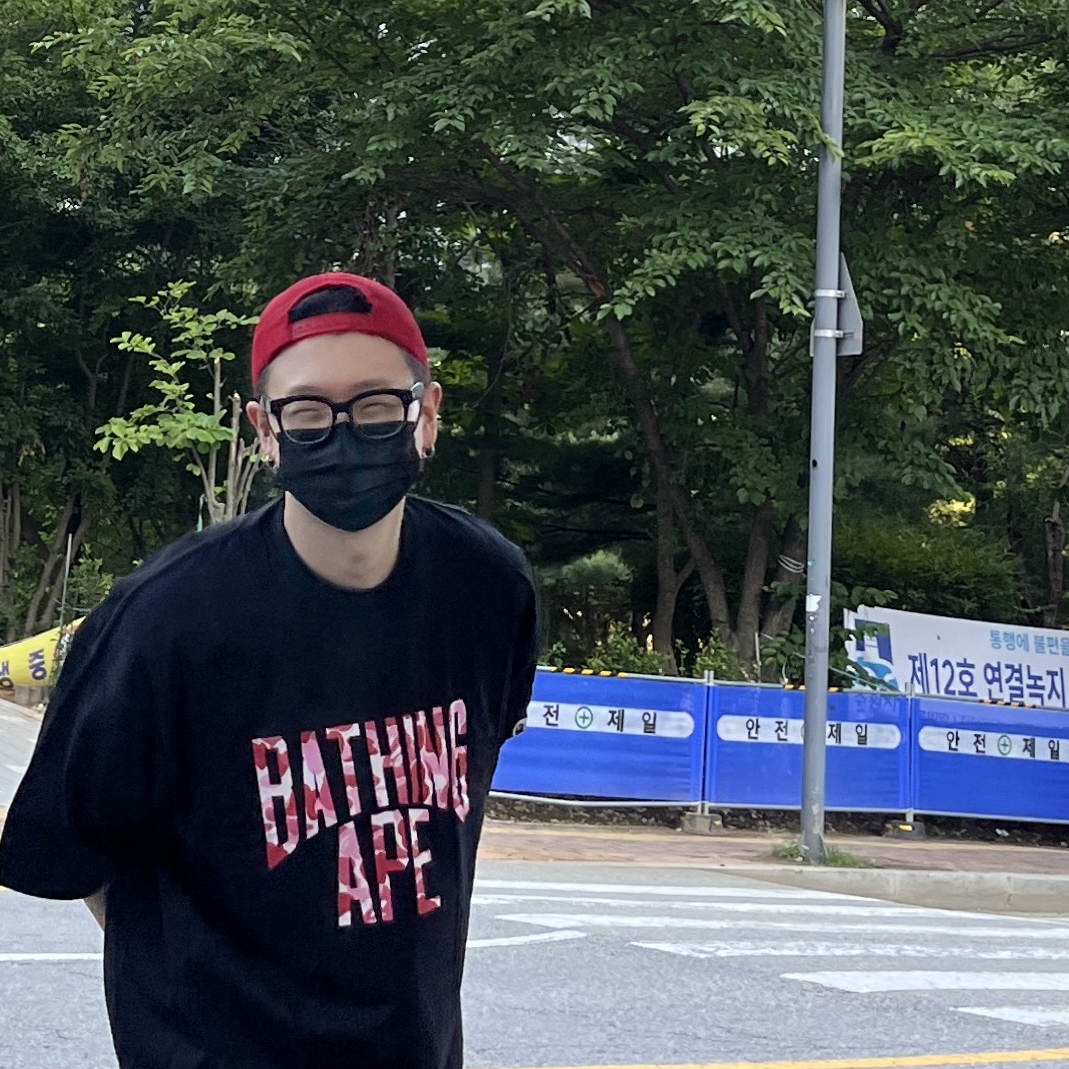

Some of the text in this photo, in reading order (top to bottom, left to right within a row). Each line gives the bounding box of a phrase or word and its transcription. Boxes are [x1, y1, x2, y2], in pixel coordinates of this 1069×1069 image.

[989, 630, 1030, 652] 통행에
[908, 652, 1066, 708] 제12호 연결녹지
[607, 709, 658, 734] 제일
[745, 718, 788, 742] 안전
[946, 731, 1060, 760] 안전 제일
[251, 698, 470, 870] BATHING
[337, 808, 442, 927] APE
